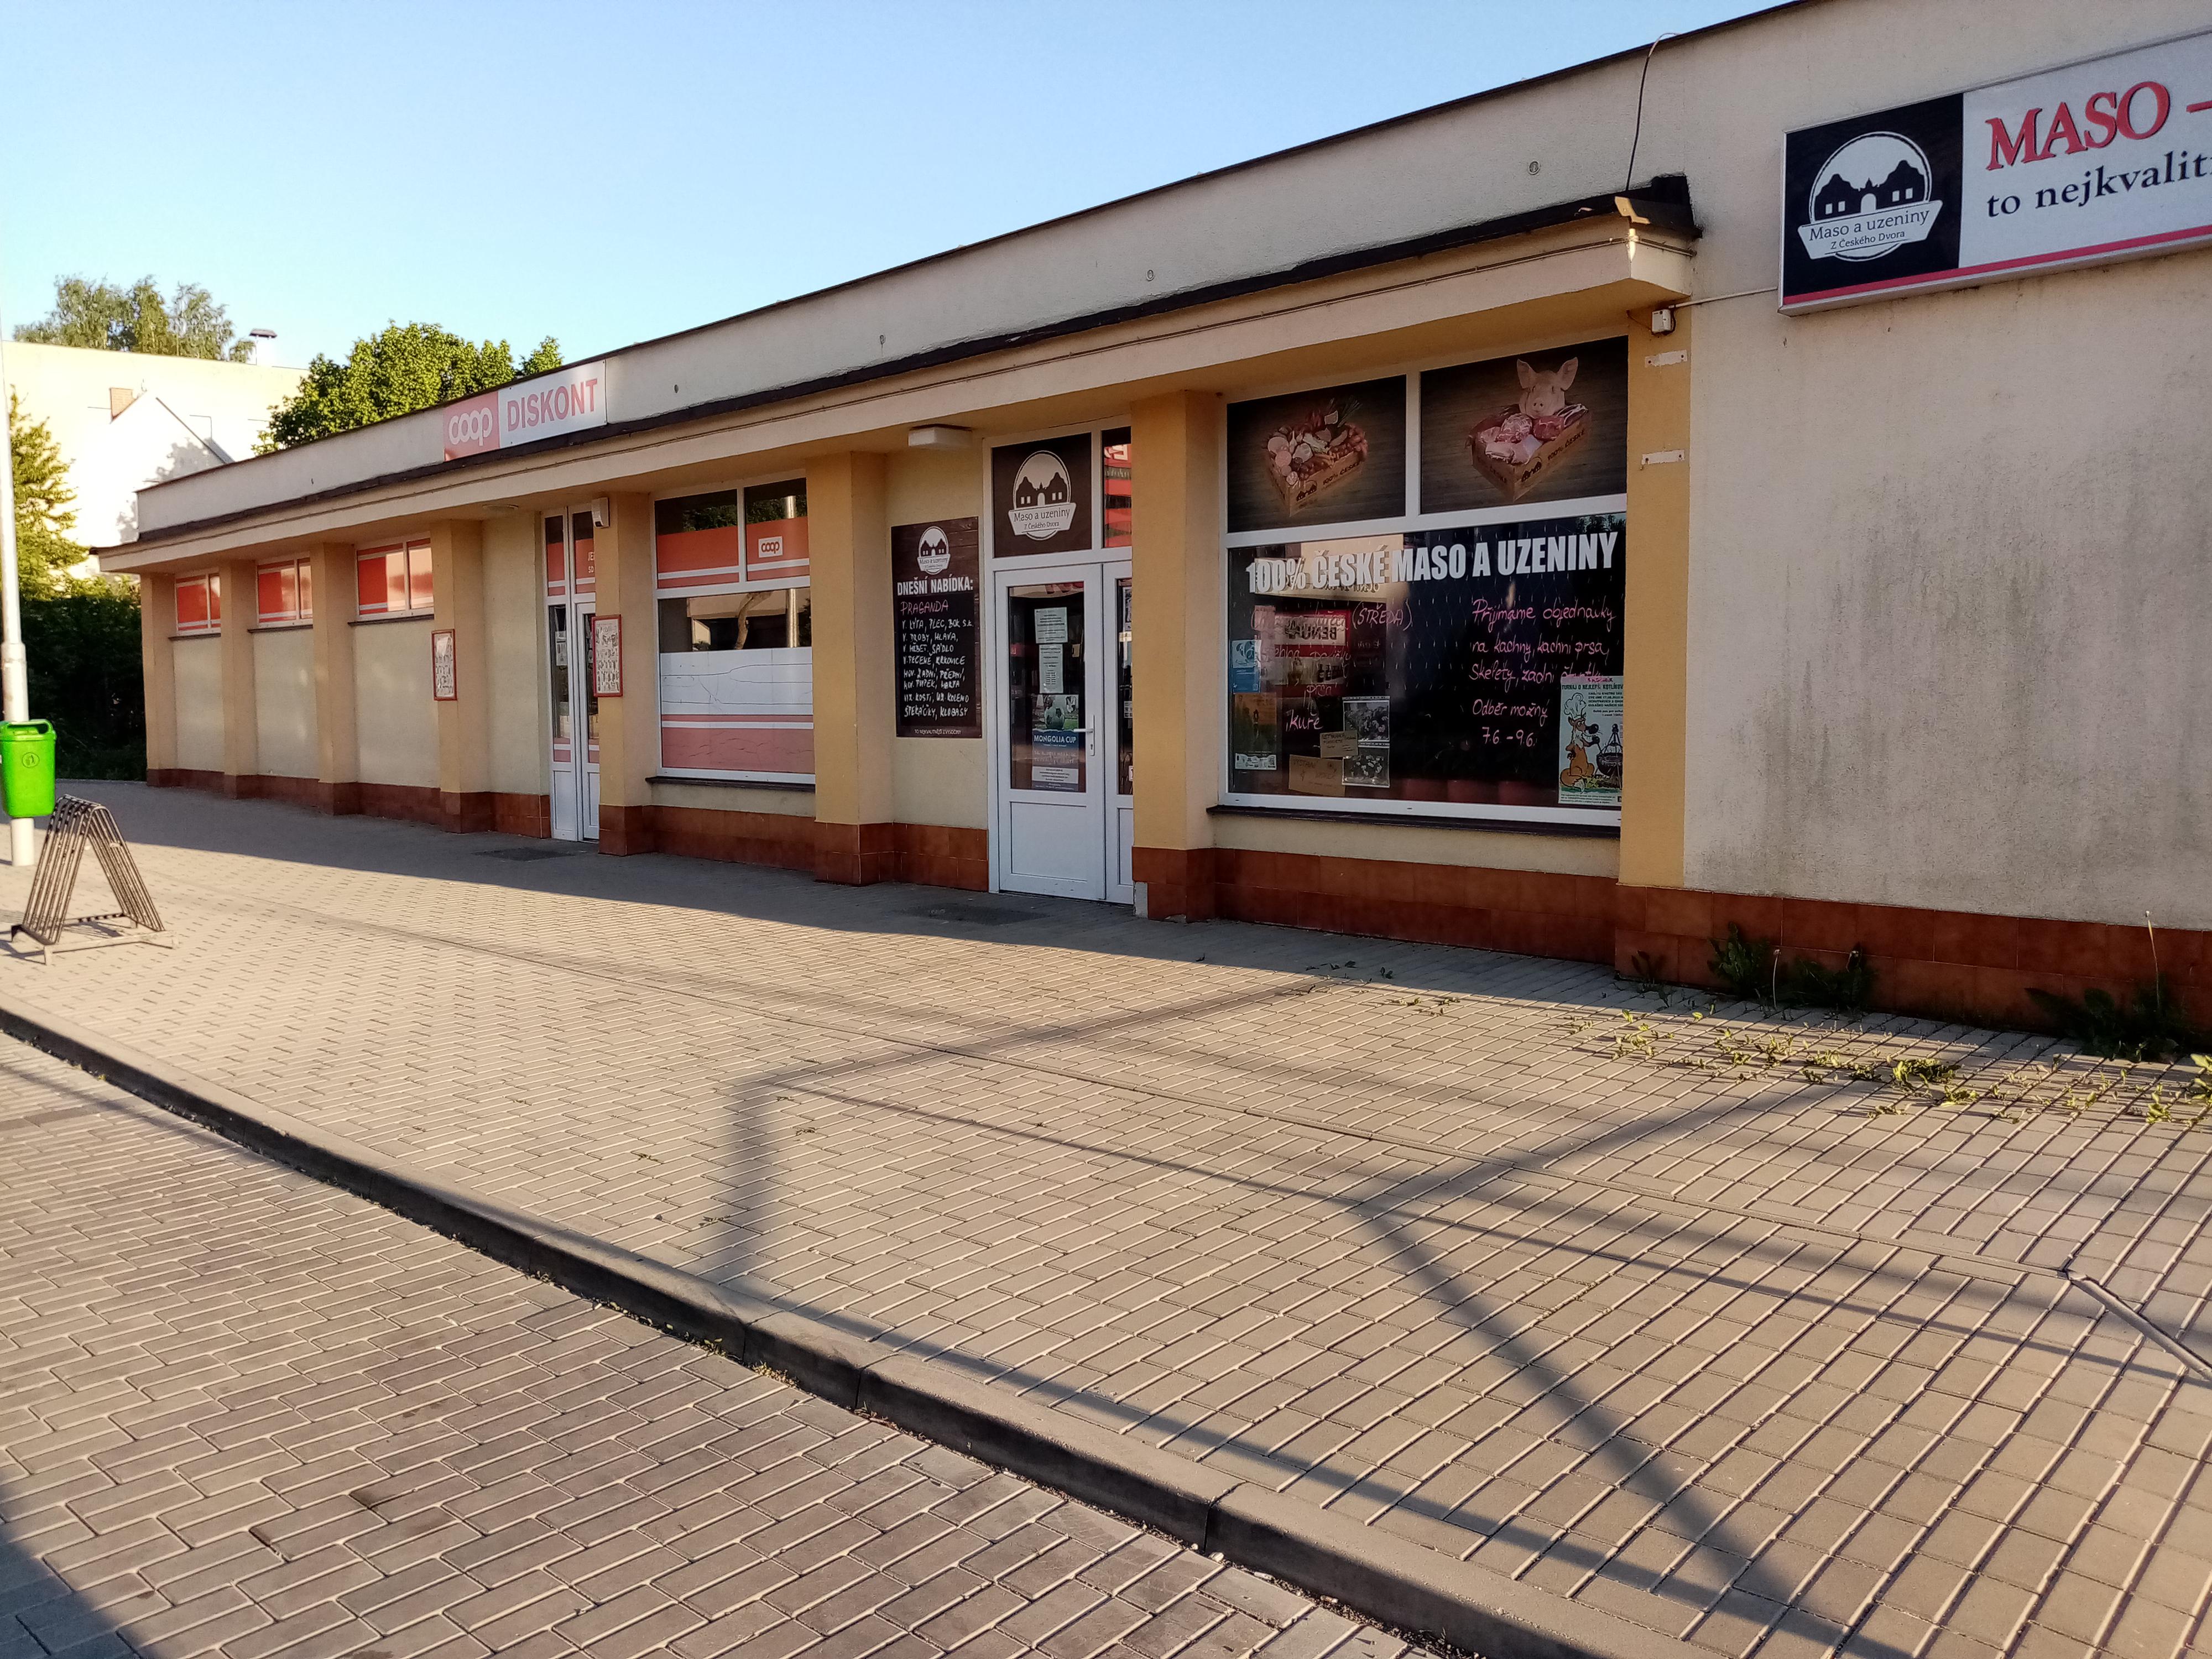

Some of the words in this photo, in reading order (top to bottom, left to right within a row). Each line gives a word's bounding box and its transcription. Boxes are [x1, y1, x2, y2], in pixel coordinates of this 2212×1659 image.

[1985, 81, 2171, 171] MASO
[1987, 195, 2021, 218] to
[2035, 150, 2212, 209] nejkvalit
[1809, 225, 1849, 241] Maso
[1854, 223, 1861, 233] a
[1866, 210, 1930, 231] uzeniny
[1839, 236, 1876, 248] Českého
[1879, 231, 1905, 241] Dvora
[507, 378, 598, 432] DISKONT
[448, 407, 493, 446] coop
[1014, 513, 1033, 522] Maso
[1041, 507, 1071, 520] uzeniny
[761, 541, 780, 554] coop
[1245, 556, 1307, 593] 100%
[1312, 545, 1386, 589] ČESKÉ
[1392, 544, 1466, 583] MASO
[1472, 542, 1491, 577] A
[1498, 531, 1619, 576] UZENINY
[897, 575, 928, 596] DNEŠNÍ
[931, 573, 974, 593] NABÍDKA:
[900, 599, 949, 616] PRAGANDA
[1034, 735, 1065, 743] MONGOLIA
